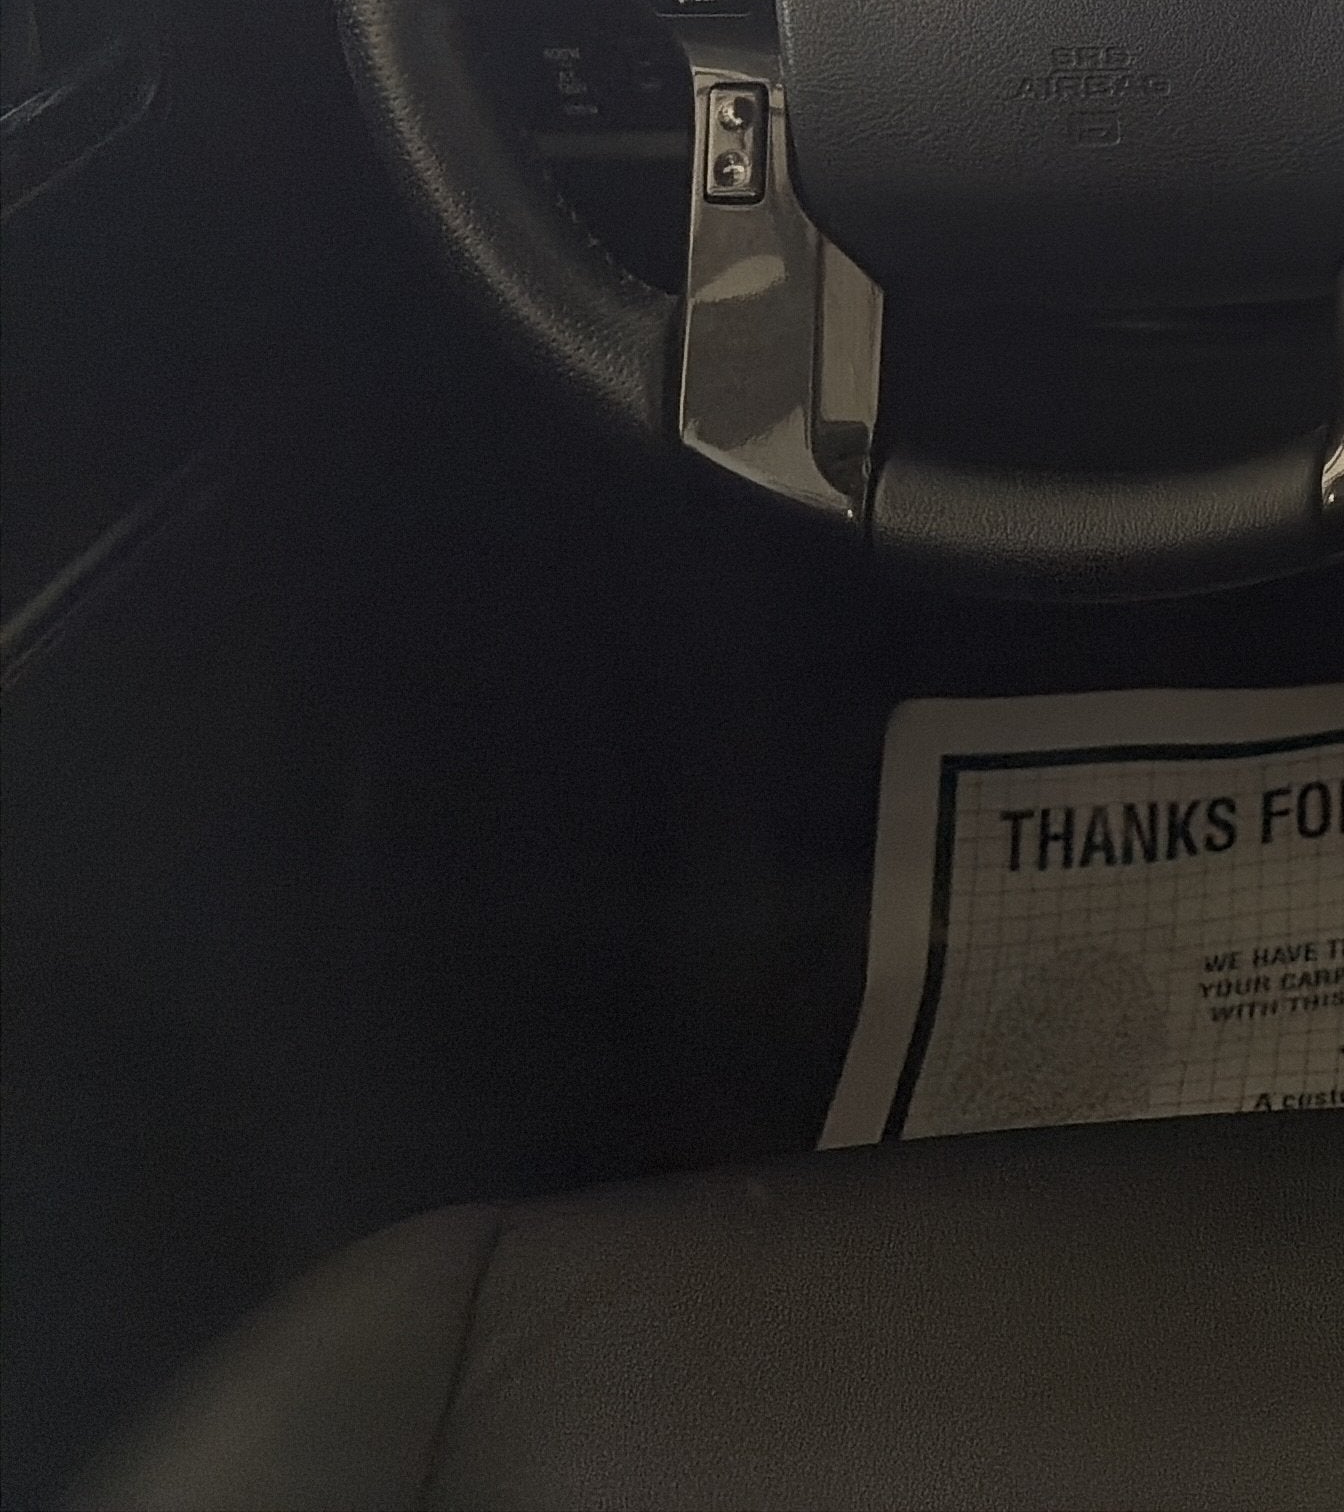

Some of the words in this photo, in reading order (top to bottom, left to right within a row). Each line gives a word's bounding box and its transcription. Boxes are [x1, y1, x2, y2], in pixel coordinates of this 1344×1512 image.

[1001, 796, 1237, 872] THANKS
[1204, 950, 1241, 973] WE
[1253, 941, 1319, 968] HAVE
[1201, 974, 1271, 999] YOUR
[1211, 1000, 1280, 1022] WITH
[1253, 1091, 1273, 1113] A
